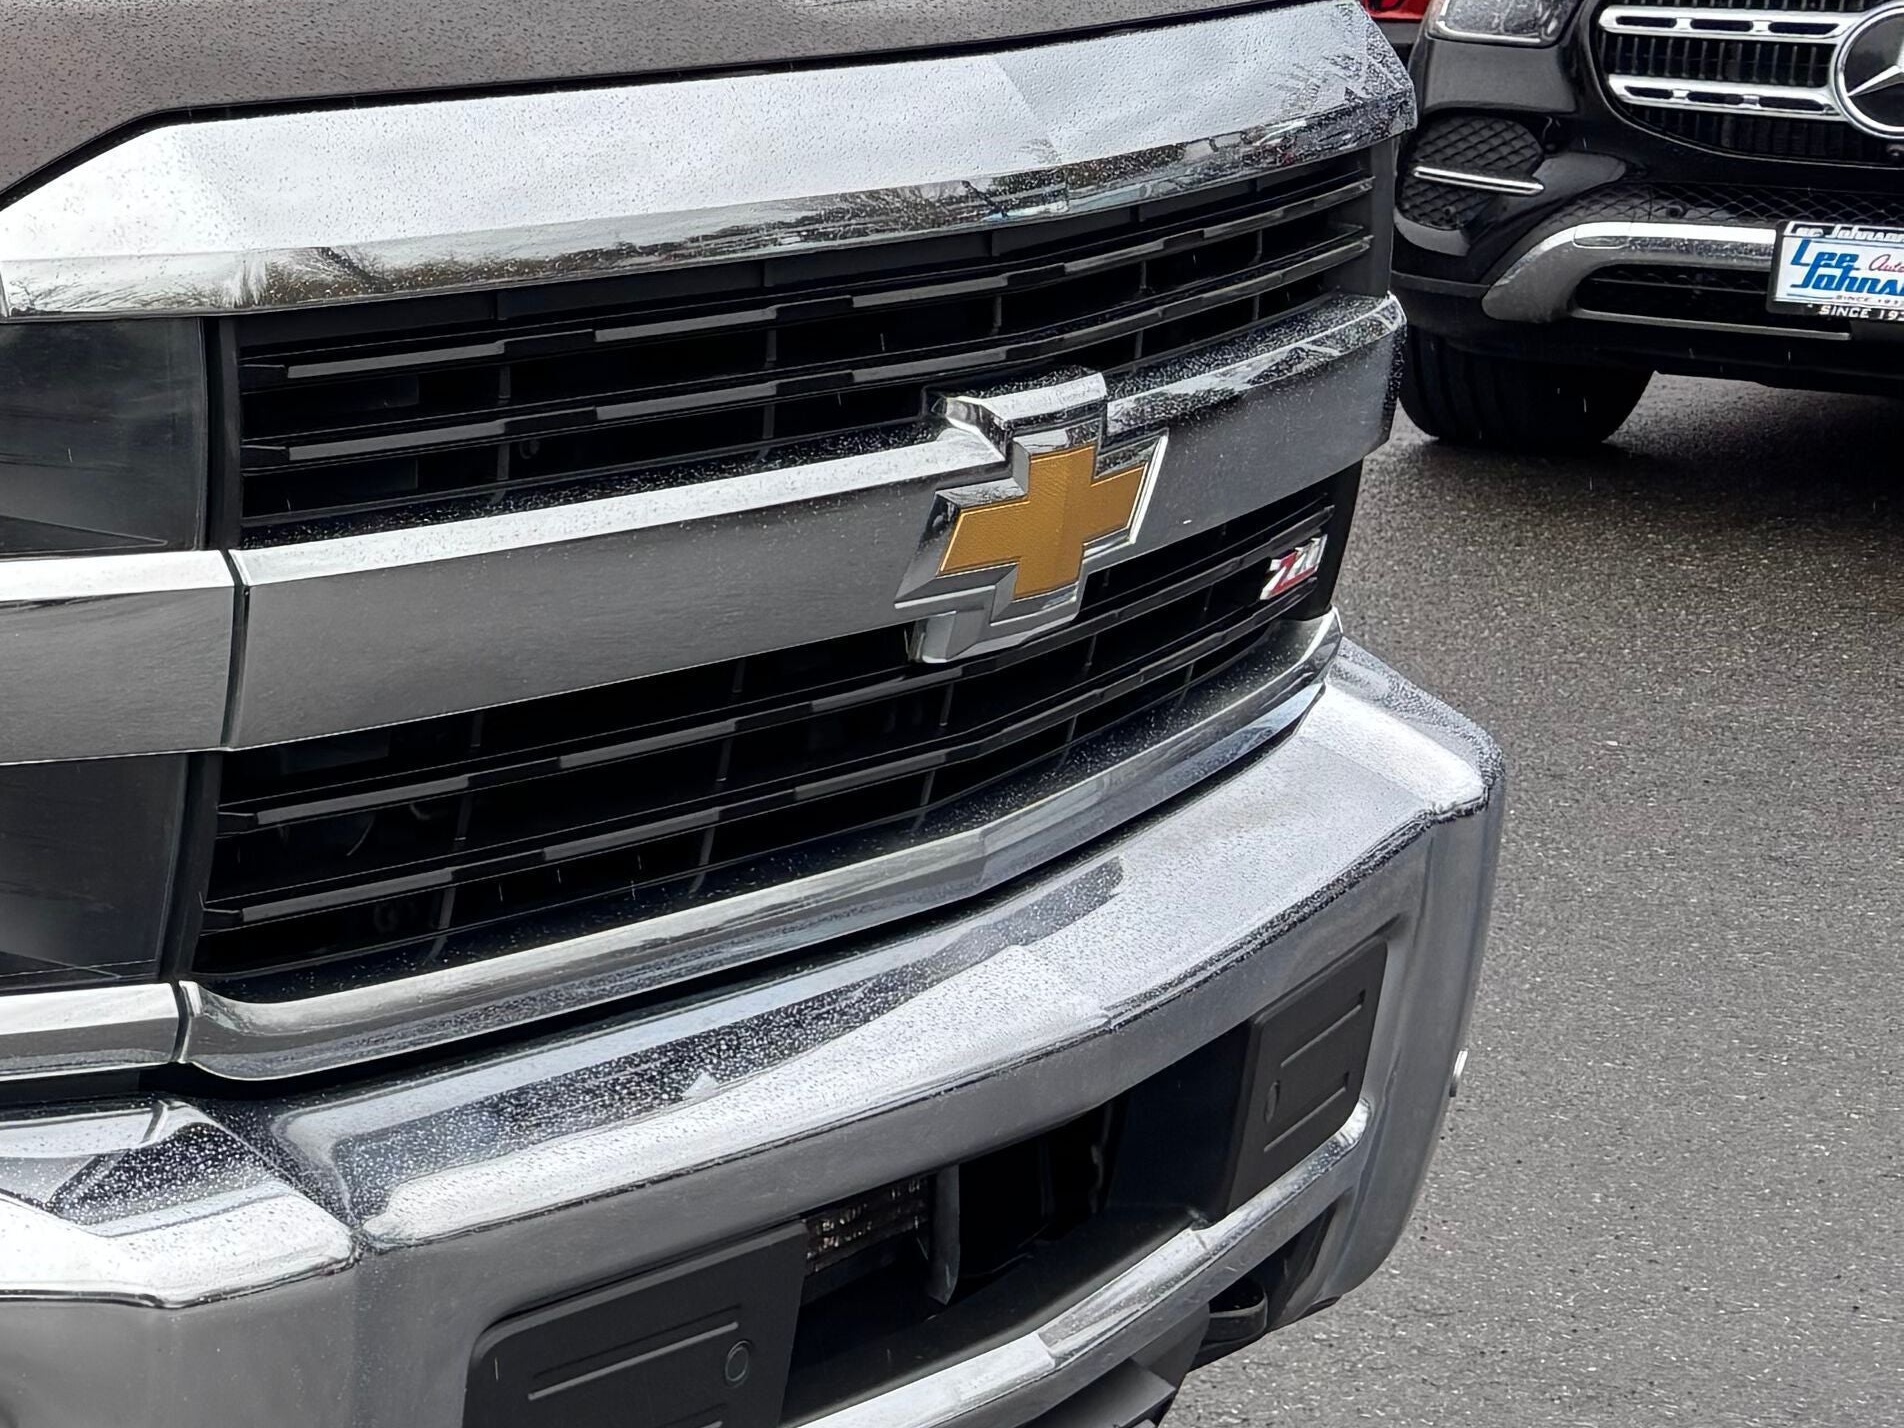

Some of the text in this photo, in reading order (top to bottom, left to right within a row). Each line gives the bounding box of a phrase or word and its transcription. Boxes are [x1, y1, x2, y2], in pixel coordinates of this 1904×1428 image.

[1790, 239, 1860, 271] Lee
[1790, 263, 1904, 296] Johns
[1819, 305, 1872, 319] SINCE
